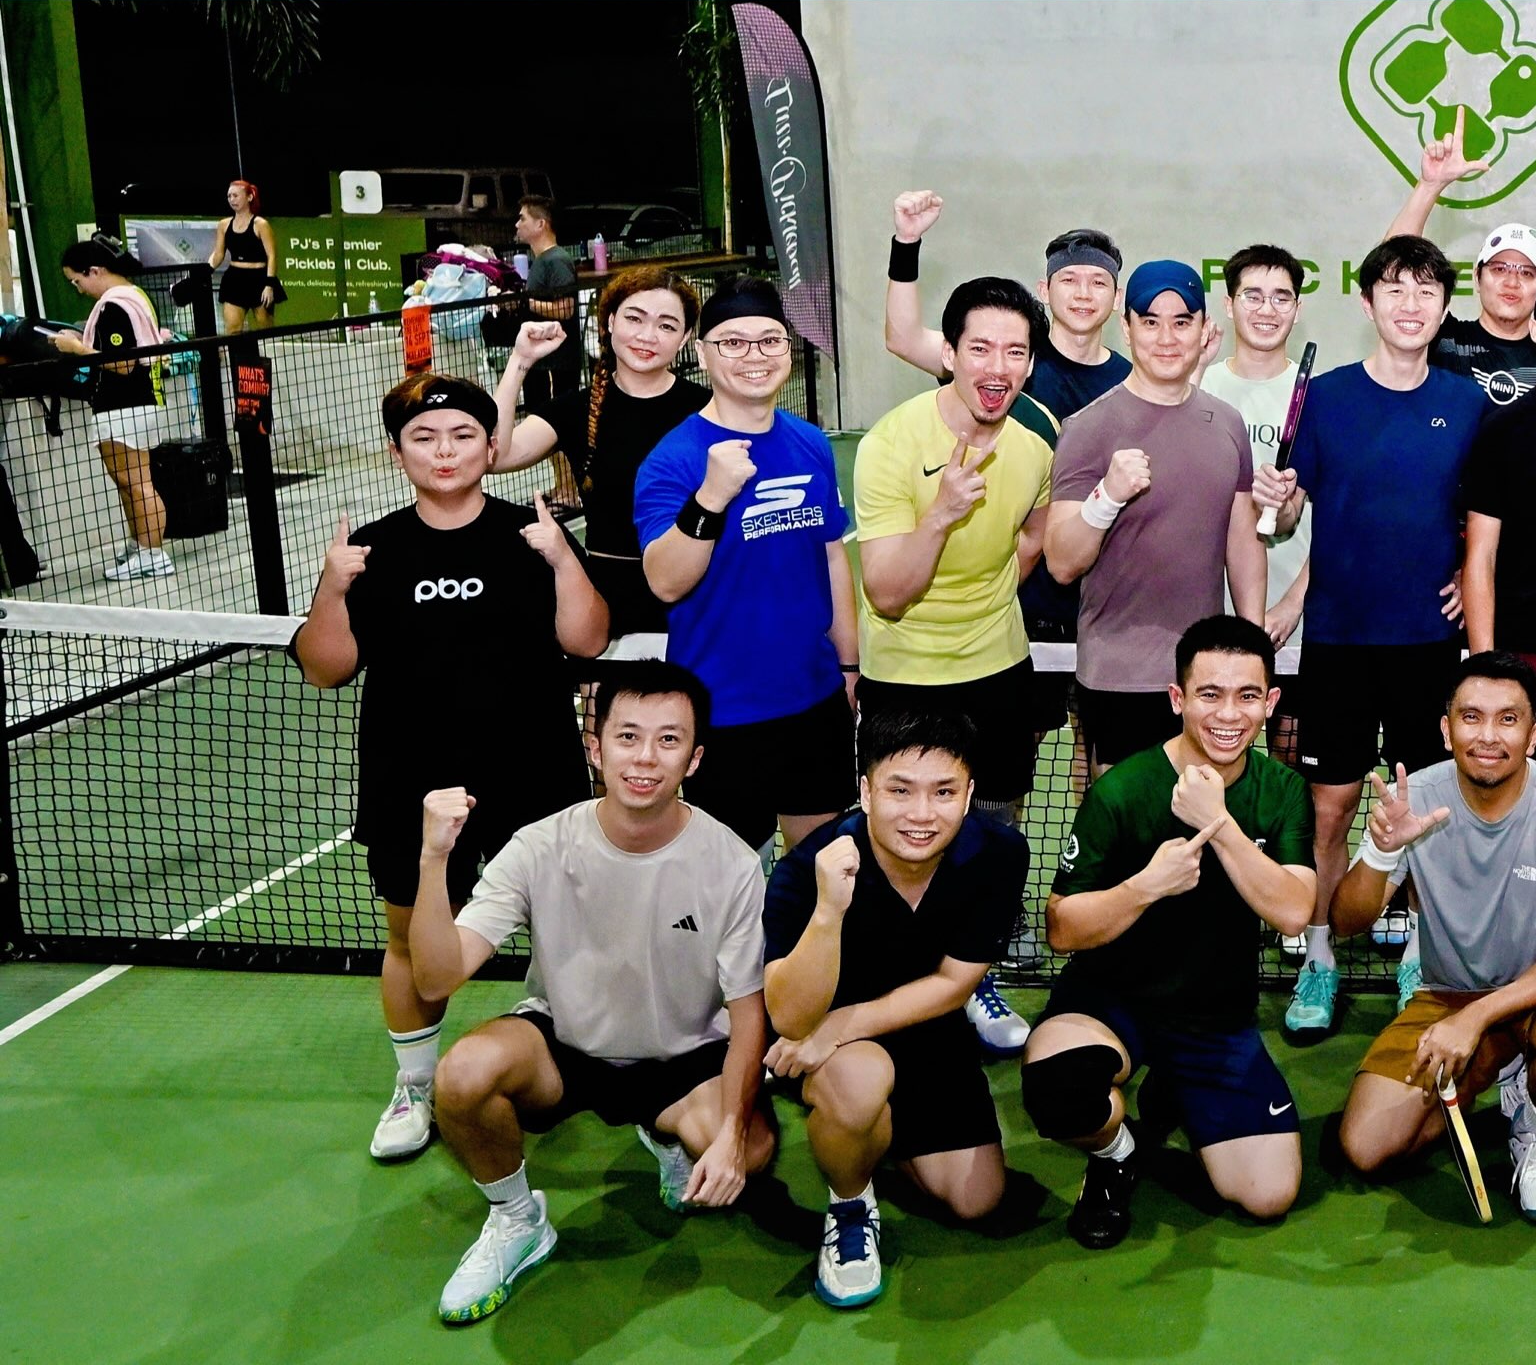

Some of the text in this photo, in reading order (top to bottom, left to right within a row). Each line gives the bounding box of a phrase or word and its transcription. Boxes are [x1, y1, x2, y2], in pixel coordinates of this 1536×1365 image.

[355, 184, 366, 200] 3
[290, 237, 383, 251] PJ's Pemier
[285, 257, 392, 271] Picklebll Club.
[238, 365, 265, 382] WHAT'S
[238, 380, 270, 397] COMING?
[1491, 381, 1515, 394] MINI
[740, 505, 824, 533] SKECHERS
[742, 516, 826, 542] PERFORMANCE
[415, 578, 484, 604] pbp
